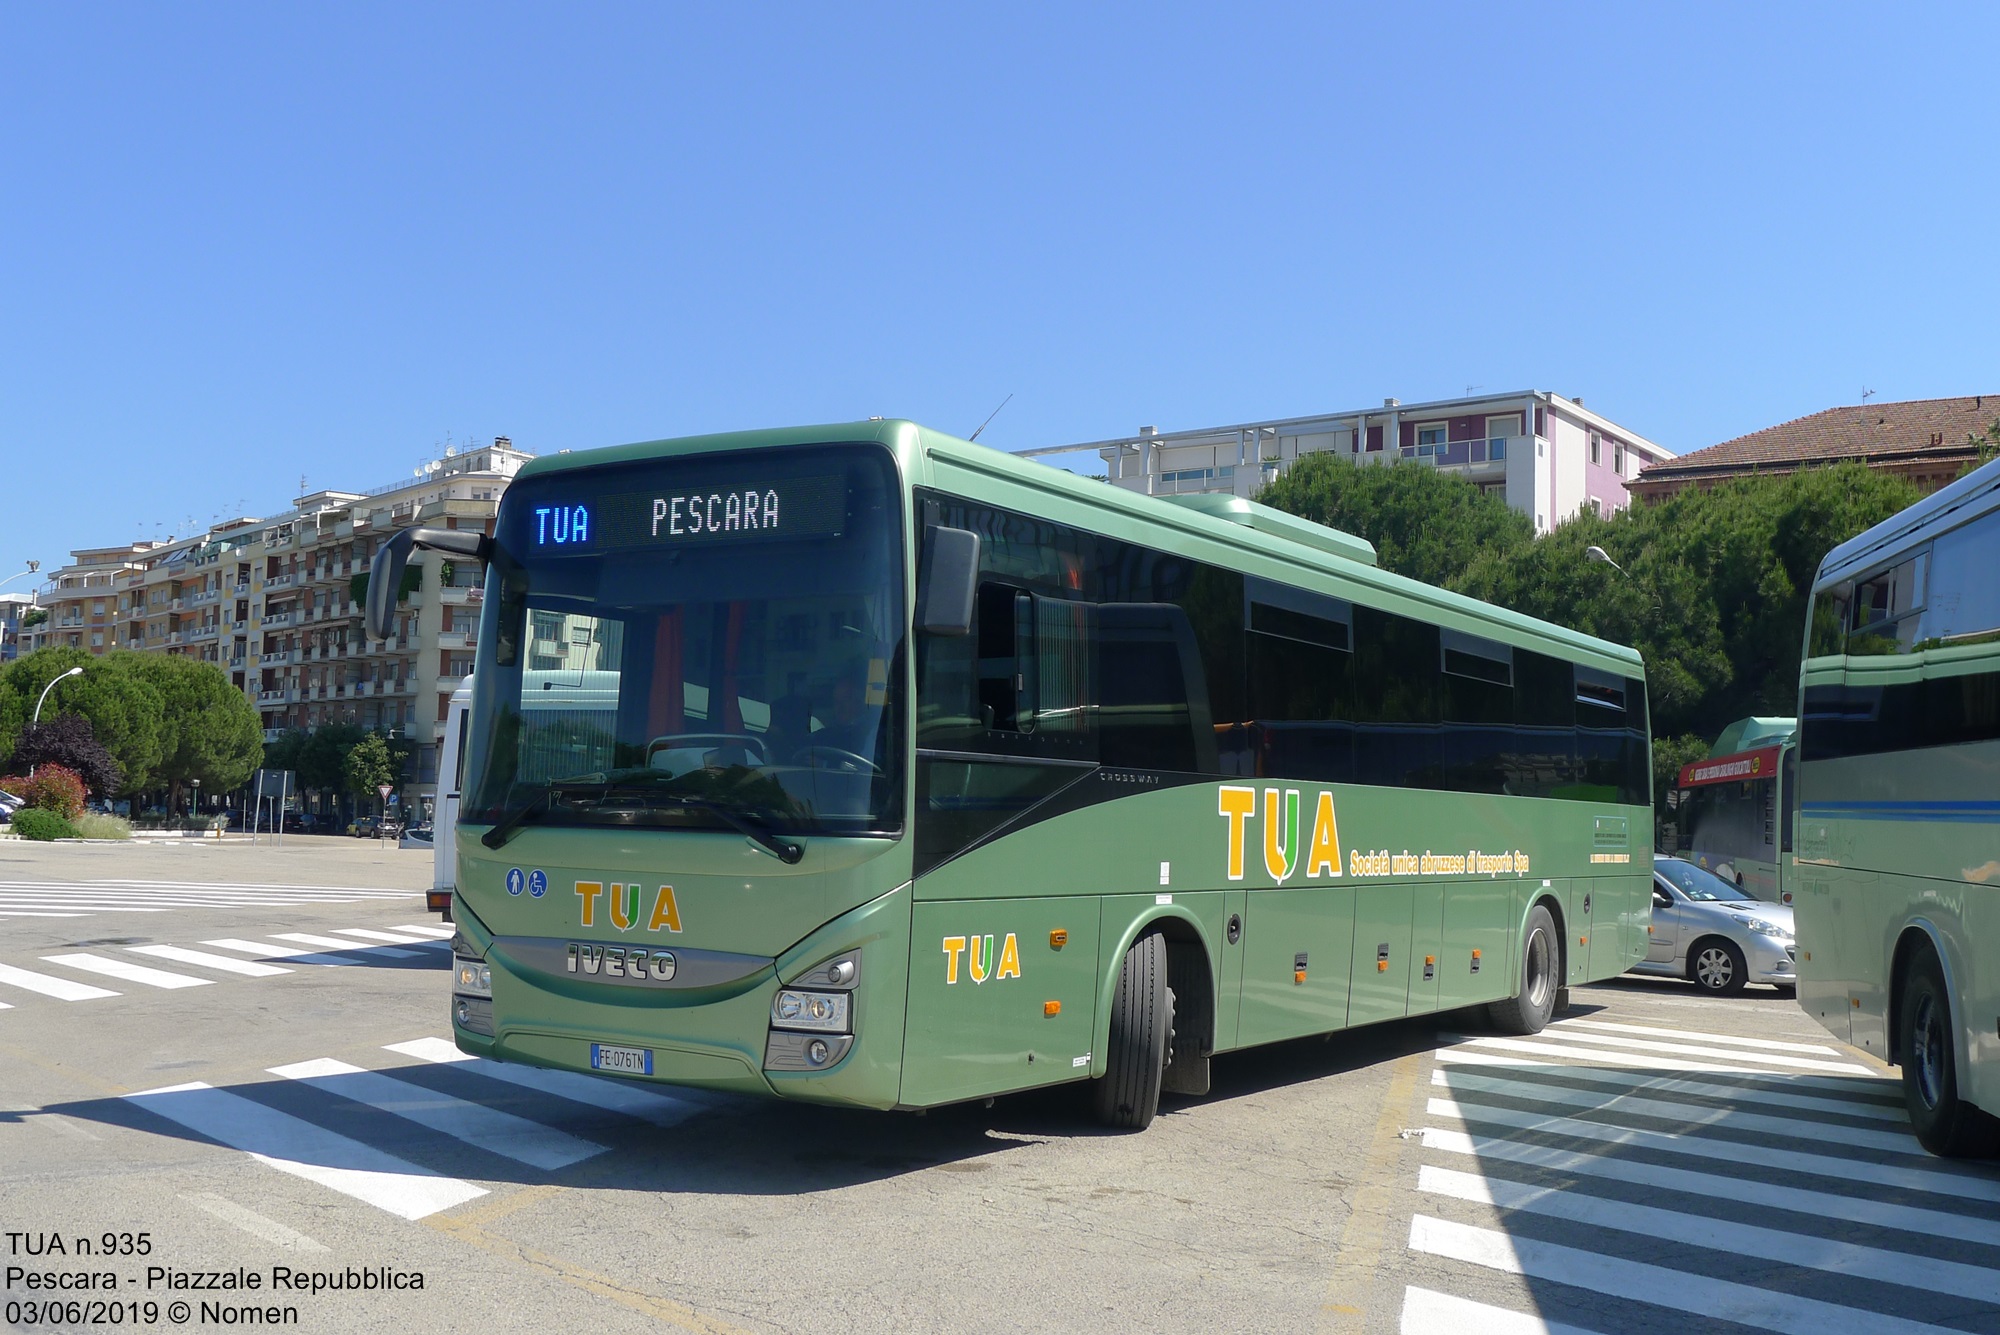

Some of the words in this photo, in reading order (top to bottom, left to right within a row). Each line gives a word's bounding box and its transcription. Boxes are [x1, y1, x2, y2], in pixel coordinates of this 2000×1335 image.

[535, 505, 589, 545] TUA
[651, 489, 780, 536] PESCARA
[1100, 772, 1160, 785] CROSSWAY
[1218, 785, 1343, 886] TUA
[1350, 849, 1391, 877] Società
[1391, 849, 1419, 876] unica
[1420, 849, 1466, 875] abruzzese
[1466, 850, 1476, 875] di
[1476, 850, 1514, 878] trasporto
[1514, 849, 1529, 878] Spa
[574, 880, 683, 934] TUA
[567, 943, 677, 982] IVECO
[942, 932, 1021, 985] TUA
